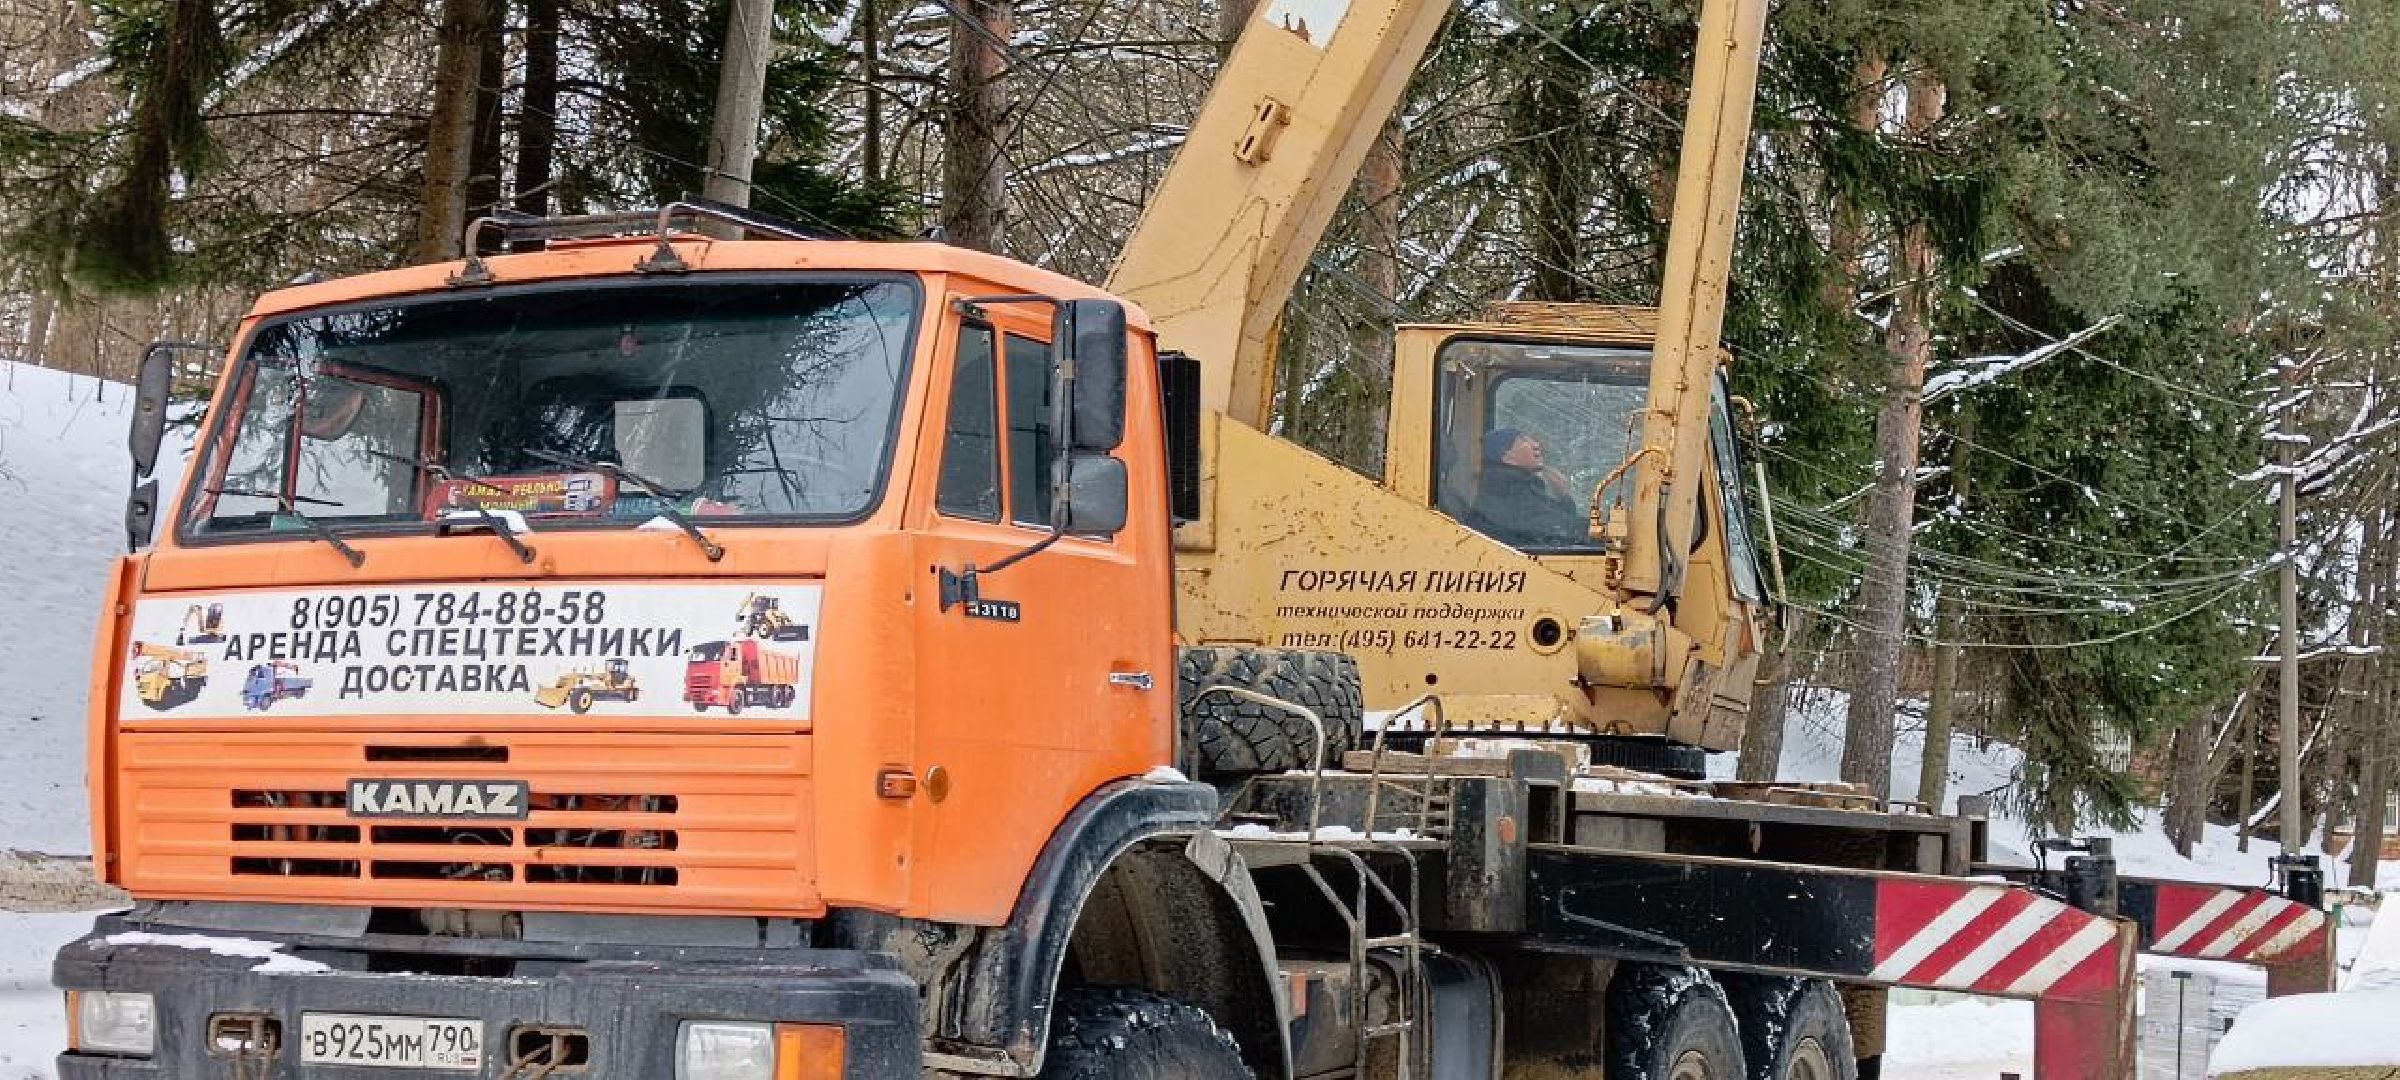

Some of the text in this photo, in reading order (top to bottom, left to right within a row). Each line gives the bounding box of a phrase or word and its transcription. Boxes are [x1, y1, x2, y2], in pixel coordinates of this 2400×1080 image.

[1279, 570, 1527, 593] ГОРЯЧАЯ ЛИНИЯ
[290, 591, 606, 629] 8(905) 784-88-58
[1276, 602, 1525, 622] технической поддержки
[223, 630, 362, 664] АРЕНДА
[1403, 630, 1516, 650] 641-22-22
[339, 664, 531, 699] ДОСТАВКА
[352, 782, 518, 814] KAMAZ
[427, 1024, 474, 1051] 790
